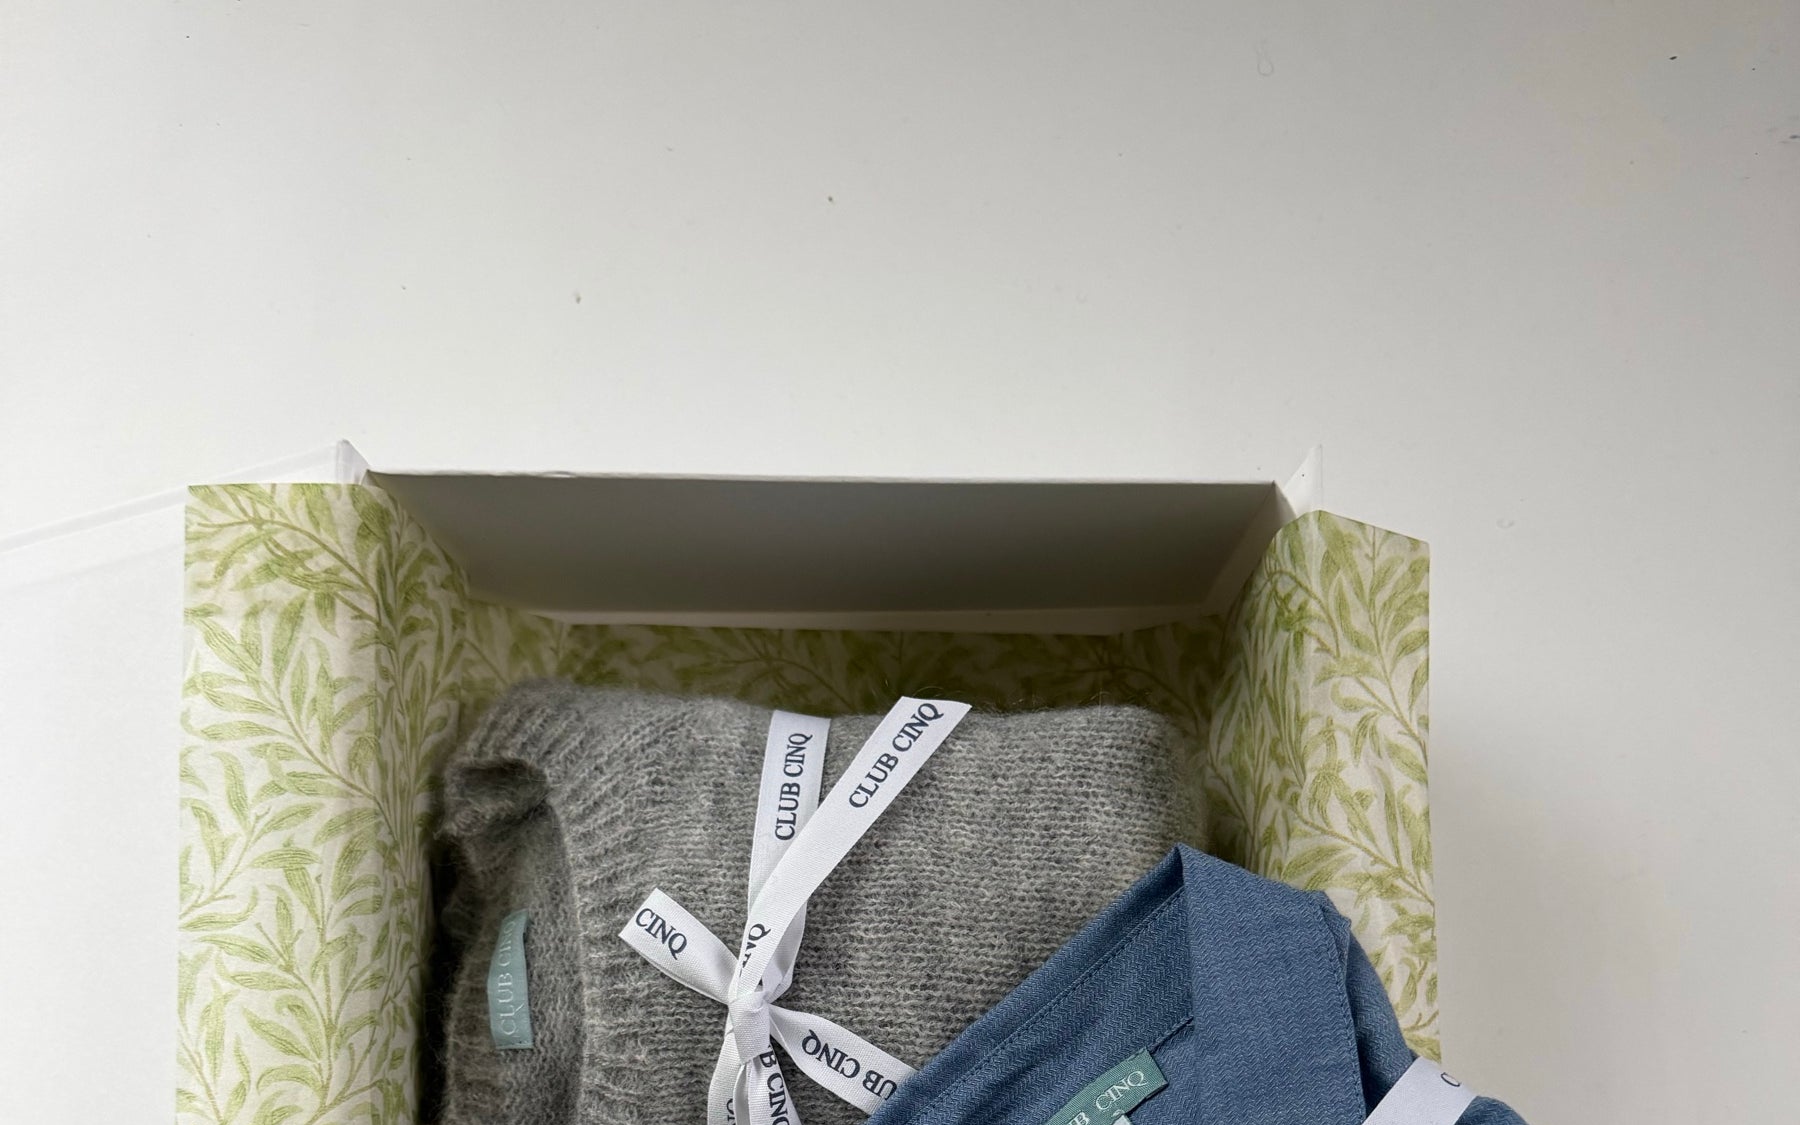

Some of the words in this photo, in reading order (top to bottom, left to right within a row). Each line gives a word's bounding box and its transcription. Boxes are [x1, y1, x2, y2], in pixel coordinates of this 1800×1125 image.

[783, 733, 813, 777] CINQ
[849, 752, 899, 808] CLUB
[892, 703, 944, 752] CINQ
[774, 782, 801, 841] CLUB
[635, 907, 687, 960] CINQ
[498, 972, 517, 1035] CLUB
[801, 1029, 861, 1079] CINQ
[862, 1069, 898, 1101] UB
[1095, 1070, 1149, 1110] CINQ
